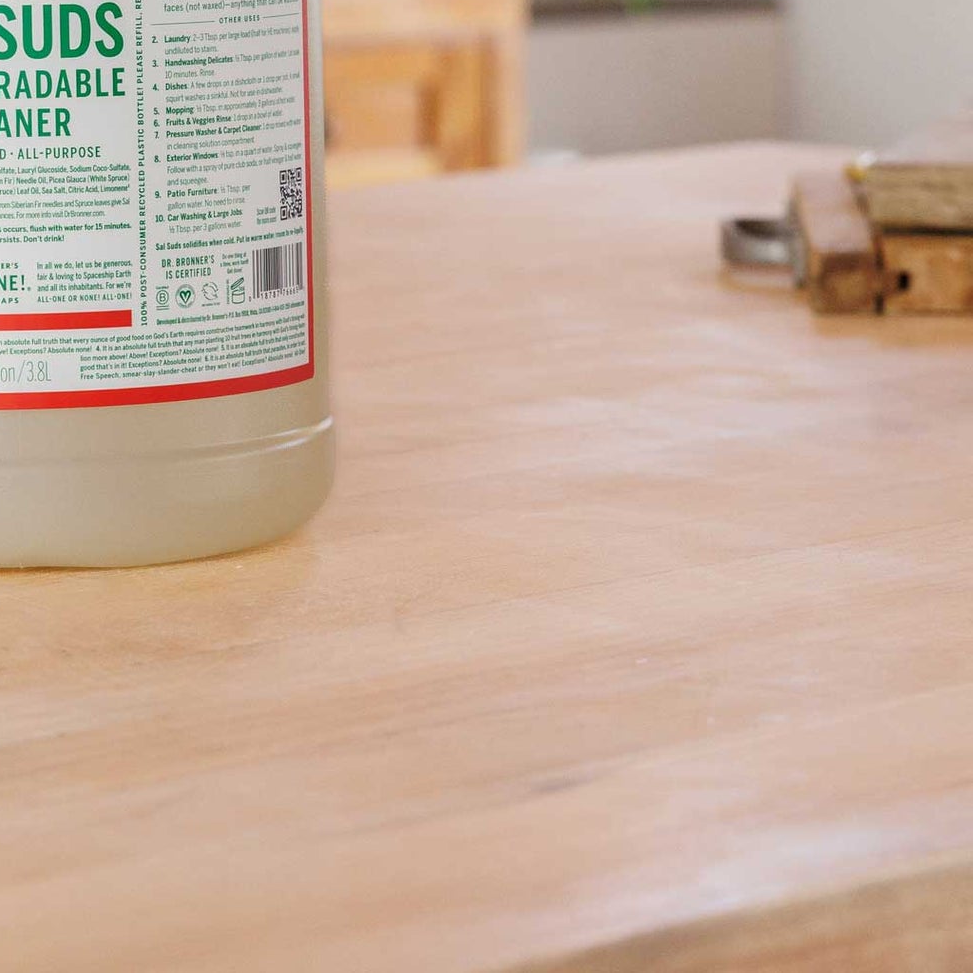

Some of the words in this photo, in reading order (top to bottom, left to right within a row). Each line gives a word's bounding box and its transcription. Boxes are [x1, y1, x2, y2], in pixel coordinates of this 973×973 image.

[219, 16, 241, 24] OTHER
[135, 13, 143, 47] REFILL,
[152, 36, 158, 44] 2.
[152, 60, 158, 68] 3.
[164, 58, 207, 67] Handwashing
[152, 83, 159, 91] 4.
[153, 119, 160, 127] 6.
[166, 118, 185, 126] Fruits
[192, 117, 215, 125] Veggies
[155, 131, 159, 139] 7.
[195, 128, 217, 136] Washer
[218, 127, 223, 135] &
[223, 126, 241, 135] Carpet
[17, 146, 101, 159] ALL-PURPOSE
[154, 155, 160, 163] 8.
[166, 154, 192, 162] Exterior
[138, 170, 146, 217] RECYCLED
[154, 191, 161, 199] 9.
[167, 190, 186, 198] Patio
[155, 215, 165, 223] 10.
[167, 214, 179, 222] Car
[180, 212, 207, 221] Washing
[207, 211, 212, 219] &
[213, 211, 229, 219] Large
[23, 235, 42, 243] Don't
[139, 220, 147, 298] POST-CONSUMER
[161, 259, 174, 268] DR.
[176, 255, 215, 267] BRONNER'S
[36, 262, 43, 270] In
[44, 262, 53, 270] all
[64, 261, 74, 269] do,
[75, 261, 84, 269] let
[103, 260, 133, 269] generous,
[37, 273, 48, 281] fair
[55, 273, 74, 281] loving
[75, 272, 82, 280] to
[83, 271, 115, 280] Spaceship
[115, 270, 132, 278] Earth
[165, 271, 173, 280] IS
[175, 268, 211, 279] CERTIFIED
[37, 284, 49, 292] and
[50, 283, 58, 291] all
[68, 283, 104, 291] inhabitants.
[116, 281, 132, 289] we're
[37, 295, 66, 303] ALL-ONE
[68, 294, 78, 302] OR
[79, 294, 100, 302] NONE!
[102, 293, 132, 301] ALL-ONE!
[140, 301, 148, 326] 100%
